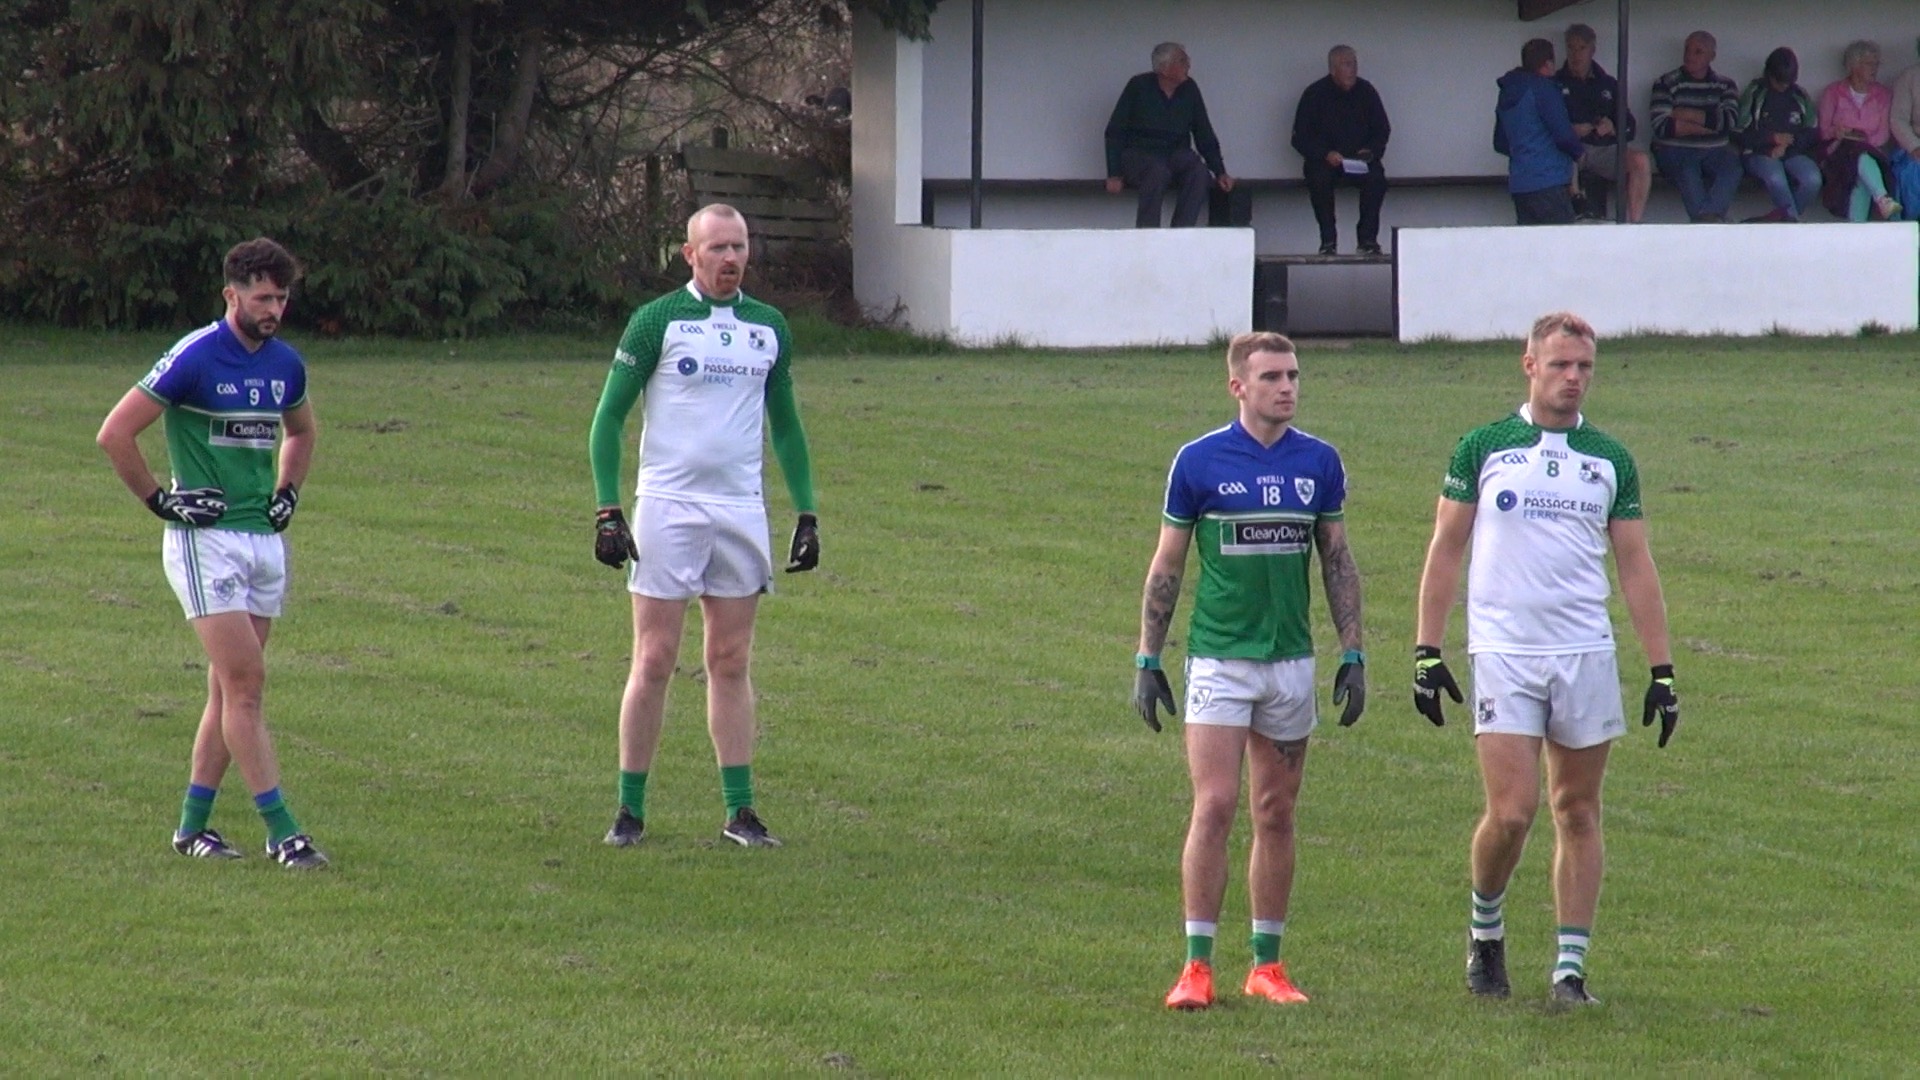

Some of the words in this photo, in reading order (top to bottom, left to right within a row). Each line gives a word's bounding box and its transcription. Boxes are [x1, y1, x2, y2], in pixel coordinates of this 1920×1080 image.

[720, 331, 732, 346] 9
[704, 364, 748, 376] PASSAGE
[703, 374, 734, 387] FERRY
[249, 388, 260, 406] 9
[1546, 460, 1560, 477] 8
[1263, 485, 1282, 506] 18
[1524, 497, 1577, 510] PASSAGE
[1580, 501, 1603, 515] EAST
[1523, 509, 1560, 522] FERRY
